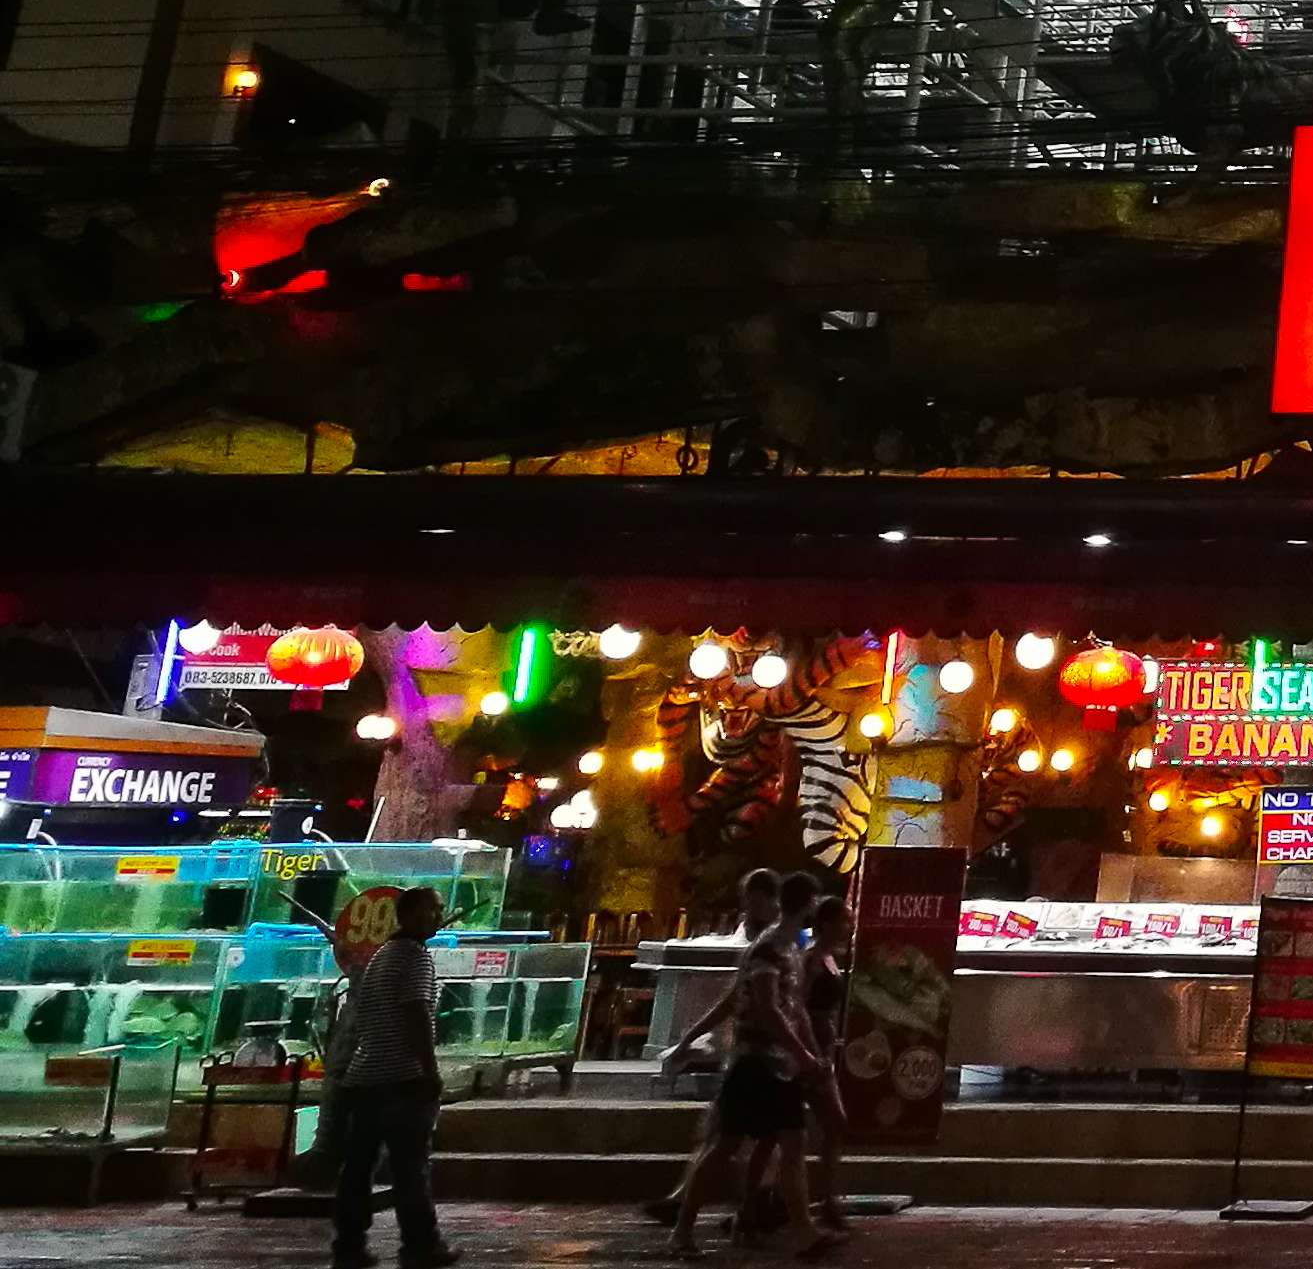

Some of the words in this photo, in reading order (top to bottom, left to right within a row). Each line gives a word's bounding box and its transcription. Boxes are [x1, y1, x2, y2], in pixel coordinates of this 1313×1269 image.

[1166, 670, 1251, 711] TIGER
[70, 767, 216, 803] EXCHANGE
[1264, 792, 1298, 808] NO
[262, 849, 323, 881] Tiger
[880, 894, 945, 920] BASKET
